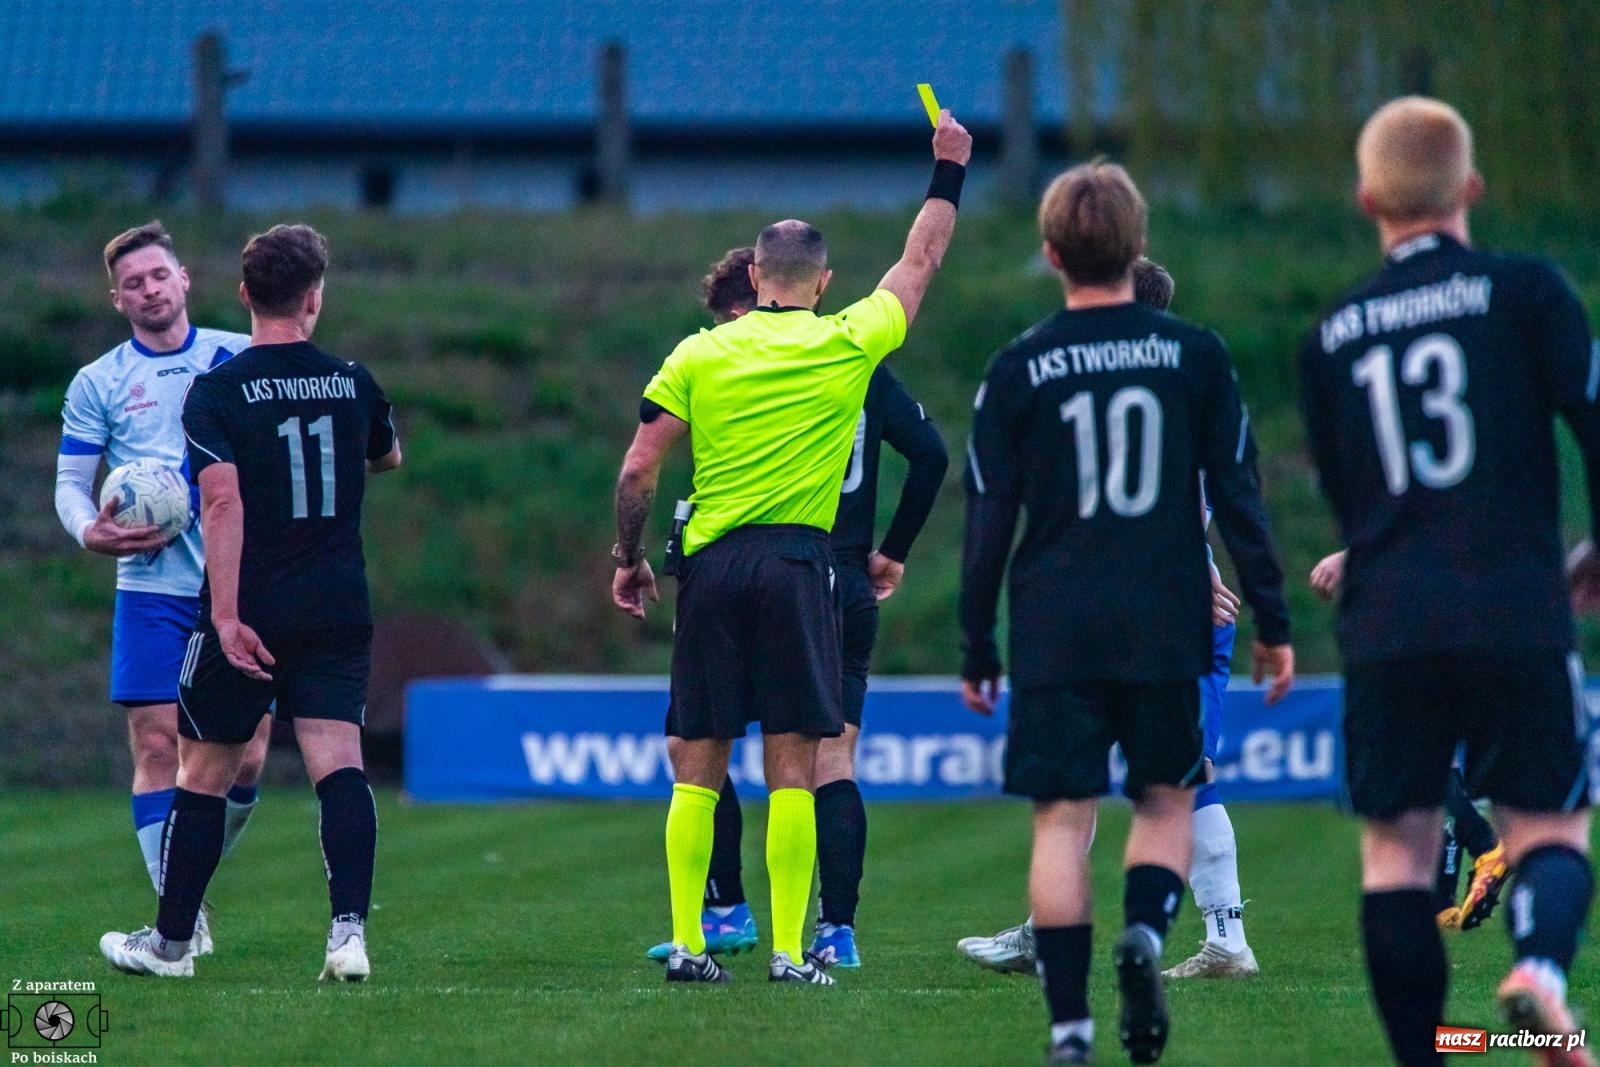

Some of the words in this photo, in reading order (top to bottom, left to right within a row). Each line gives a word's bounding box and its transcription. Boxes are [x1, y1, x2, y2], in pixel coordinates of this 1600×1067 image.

[241, 378, 273, 403] LKS
[272, 372, 356, 400] TWORKÓW
[1028, 347, 1069, 387] LKS
[1068, 333, 1181, 374] TWORKÓW
[1059, 385, 1164, 519] 10
[1351, 332, 1477, 496] 13
[277, 415, 336, 518] 11
